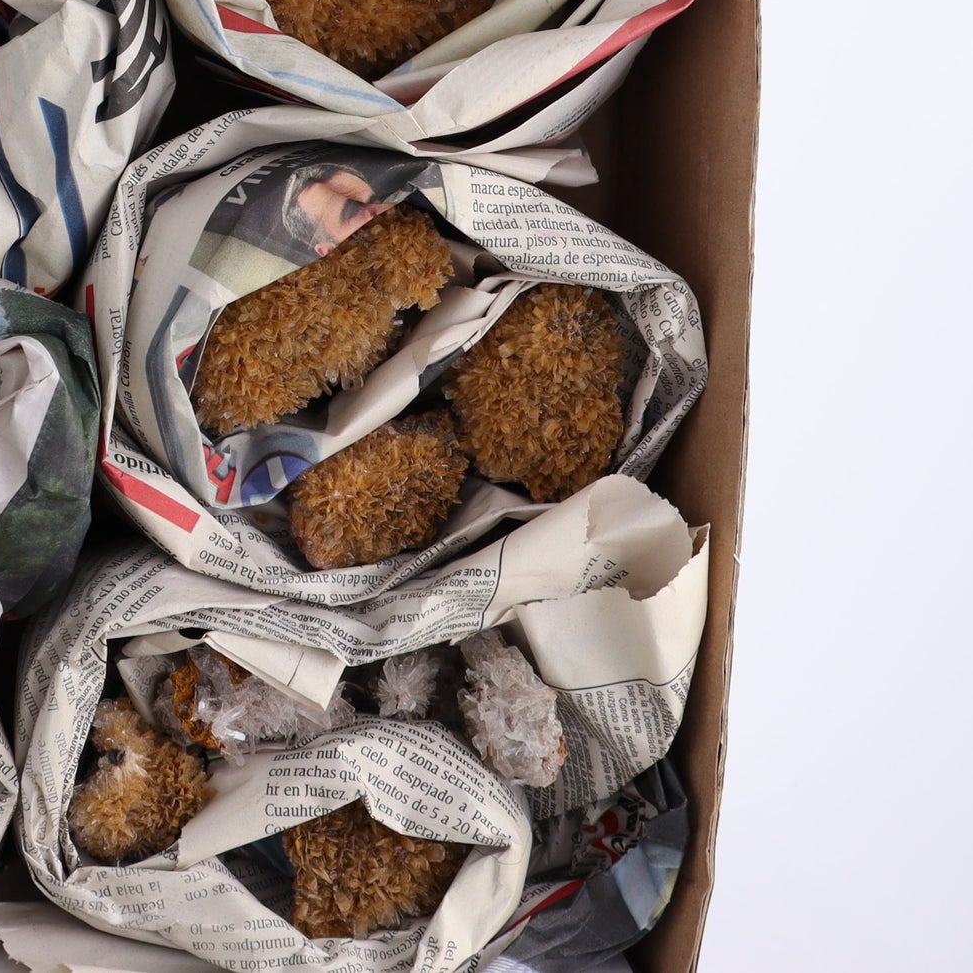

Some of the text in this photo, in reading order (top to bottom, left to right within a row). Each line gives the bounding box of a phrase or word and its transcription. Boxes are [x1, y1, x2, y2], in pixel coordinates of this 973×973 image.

[152, 125, 205, 180] Hidalgo del
[470, 182, 505, 197] marca
[472, 199, 554, 217] de carpintería,
[525, 218, 584, 234] jardinería,
[526, 233, 634, 253] pisos y mucho más
[564, 251, 654, 270] de especialistas
[560, 268, 629, 283] ceremonia
[108, 308, 123, 357] lograr
[208, 531, 234, 551] este
[199, 549, 257, 583] ha tenido
[281, 572, 348, 586] los avances
[102, 562, 167, 625] ya no aparece
[273, 750, 313, 761] mente
[268, 766, 337, 779] con rachas
[360, 744, 468, 813] cielo despejado a
[378, 734, 488, 806] en la zona serrana.
[265, 783, 281, 796] hr
[283, 785, 301, 797] en
[367, 774, 472, 835] vientos de 5 a 20
[394, 811, 441, 841] superar
[116, 881, 161, 897] la baja
[184, 890, 209, 902] con
[119, 899, 166, 915] Beatriz
[190, 922, 235, 936] son 10
